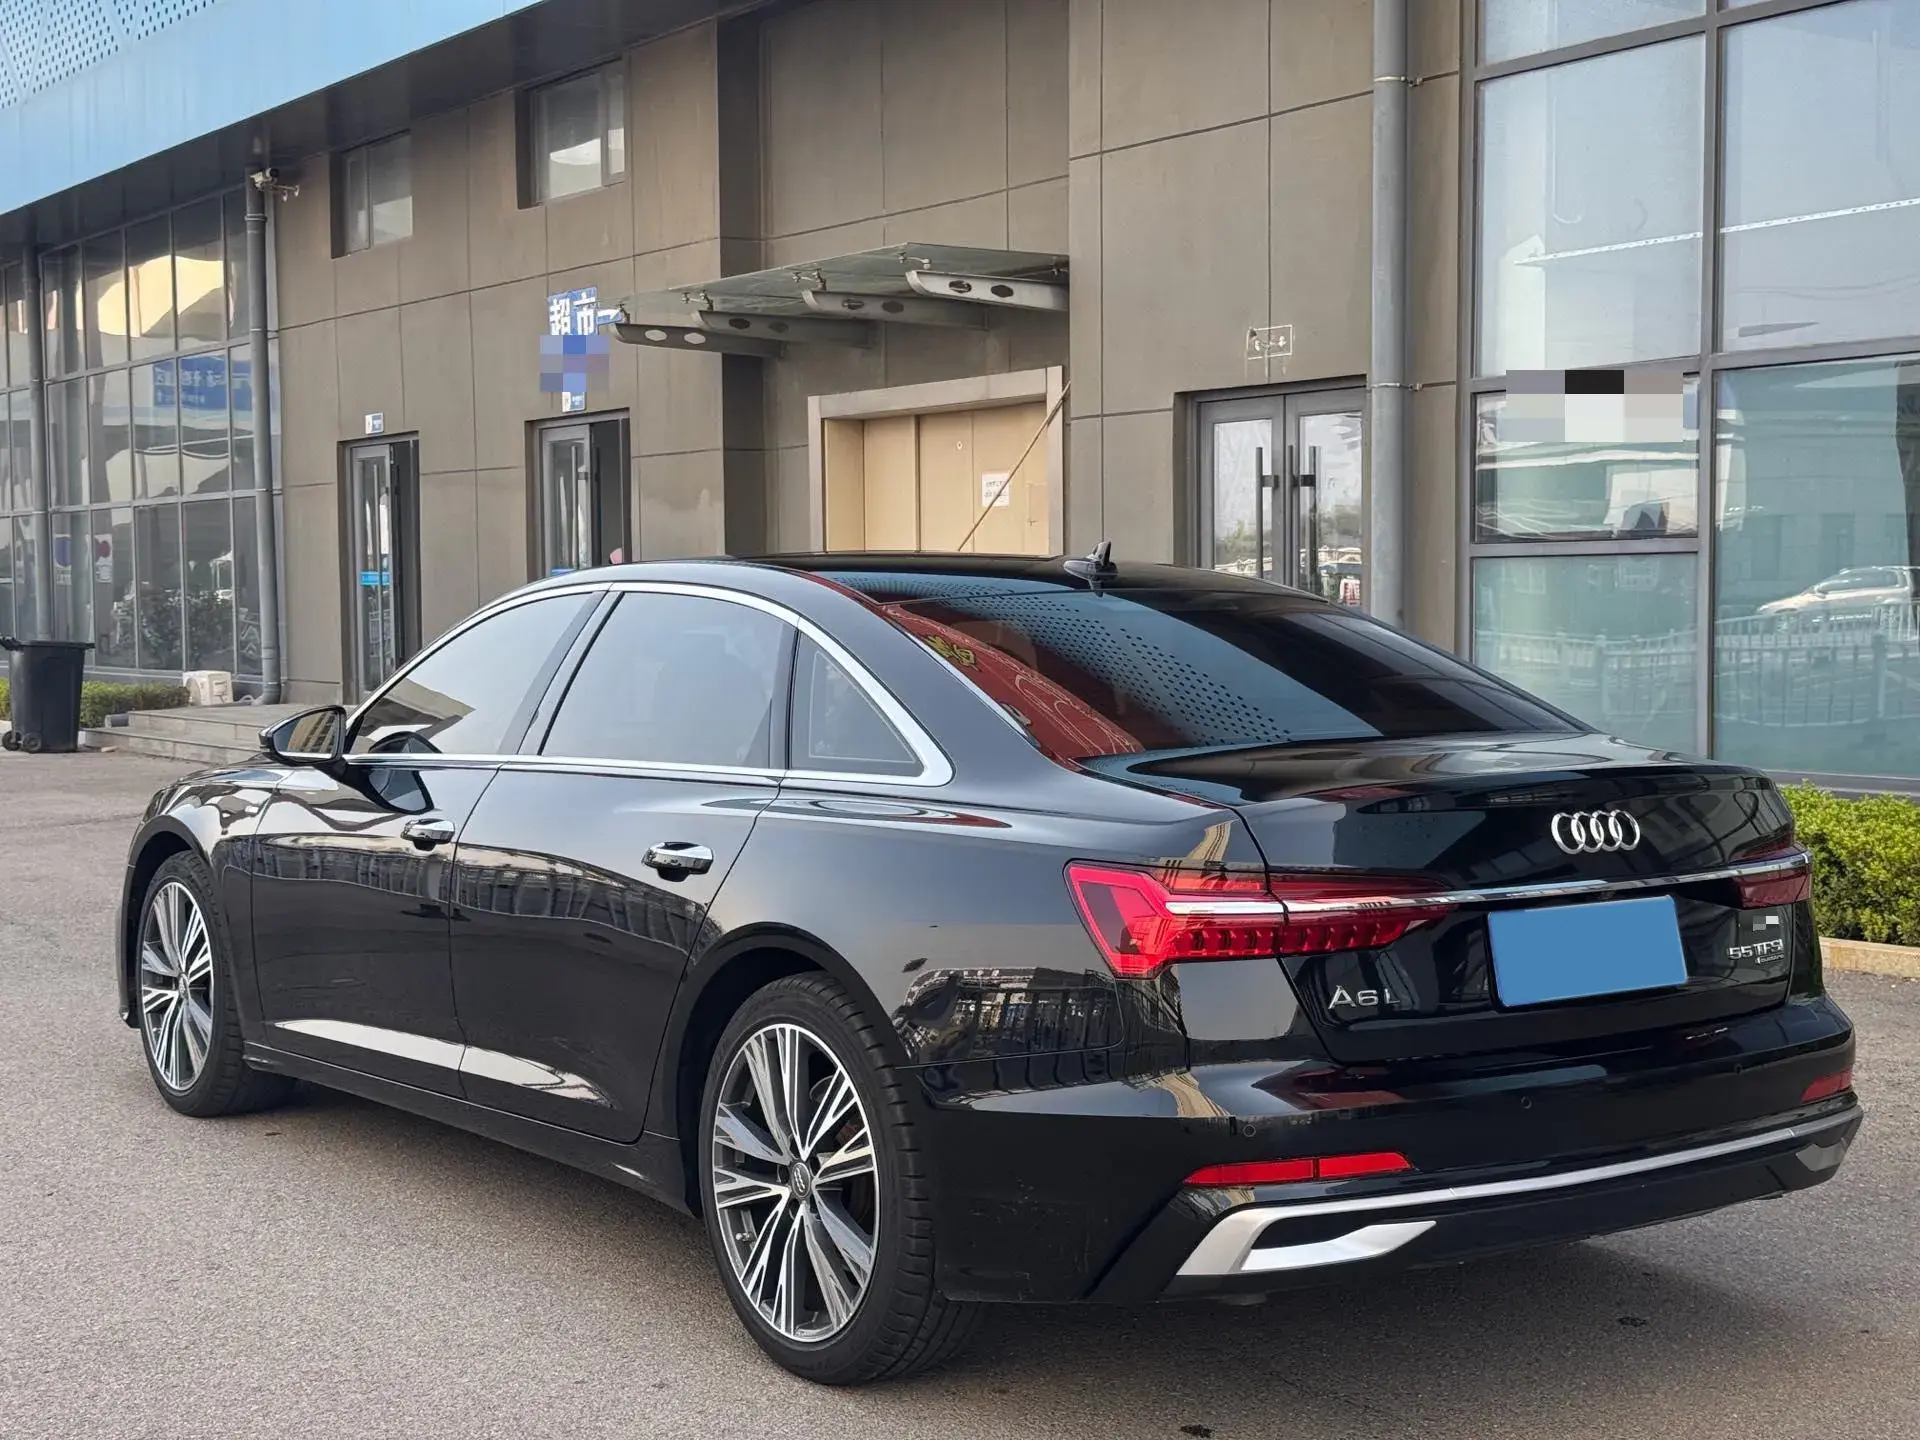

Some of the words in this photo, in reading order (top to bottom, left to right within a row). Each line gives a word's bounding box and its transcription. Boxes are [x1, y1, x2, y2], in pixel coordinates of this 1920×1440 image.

[549, 292, 596, 335] 超市
[1728, 946, 1753, 960] 55
[1753, 939, 1784, 955] TFSI
